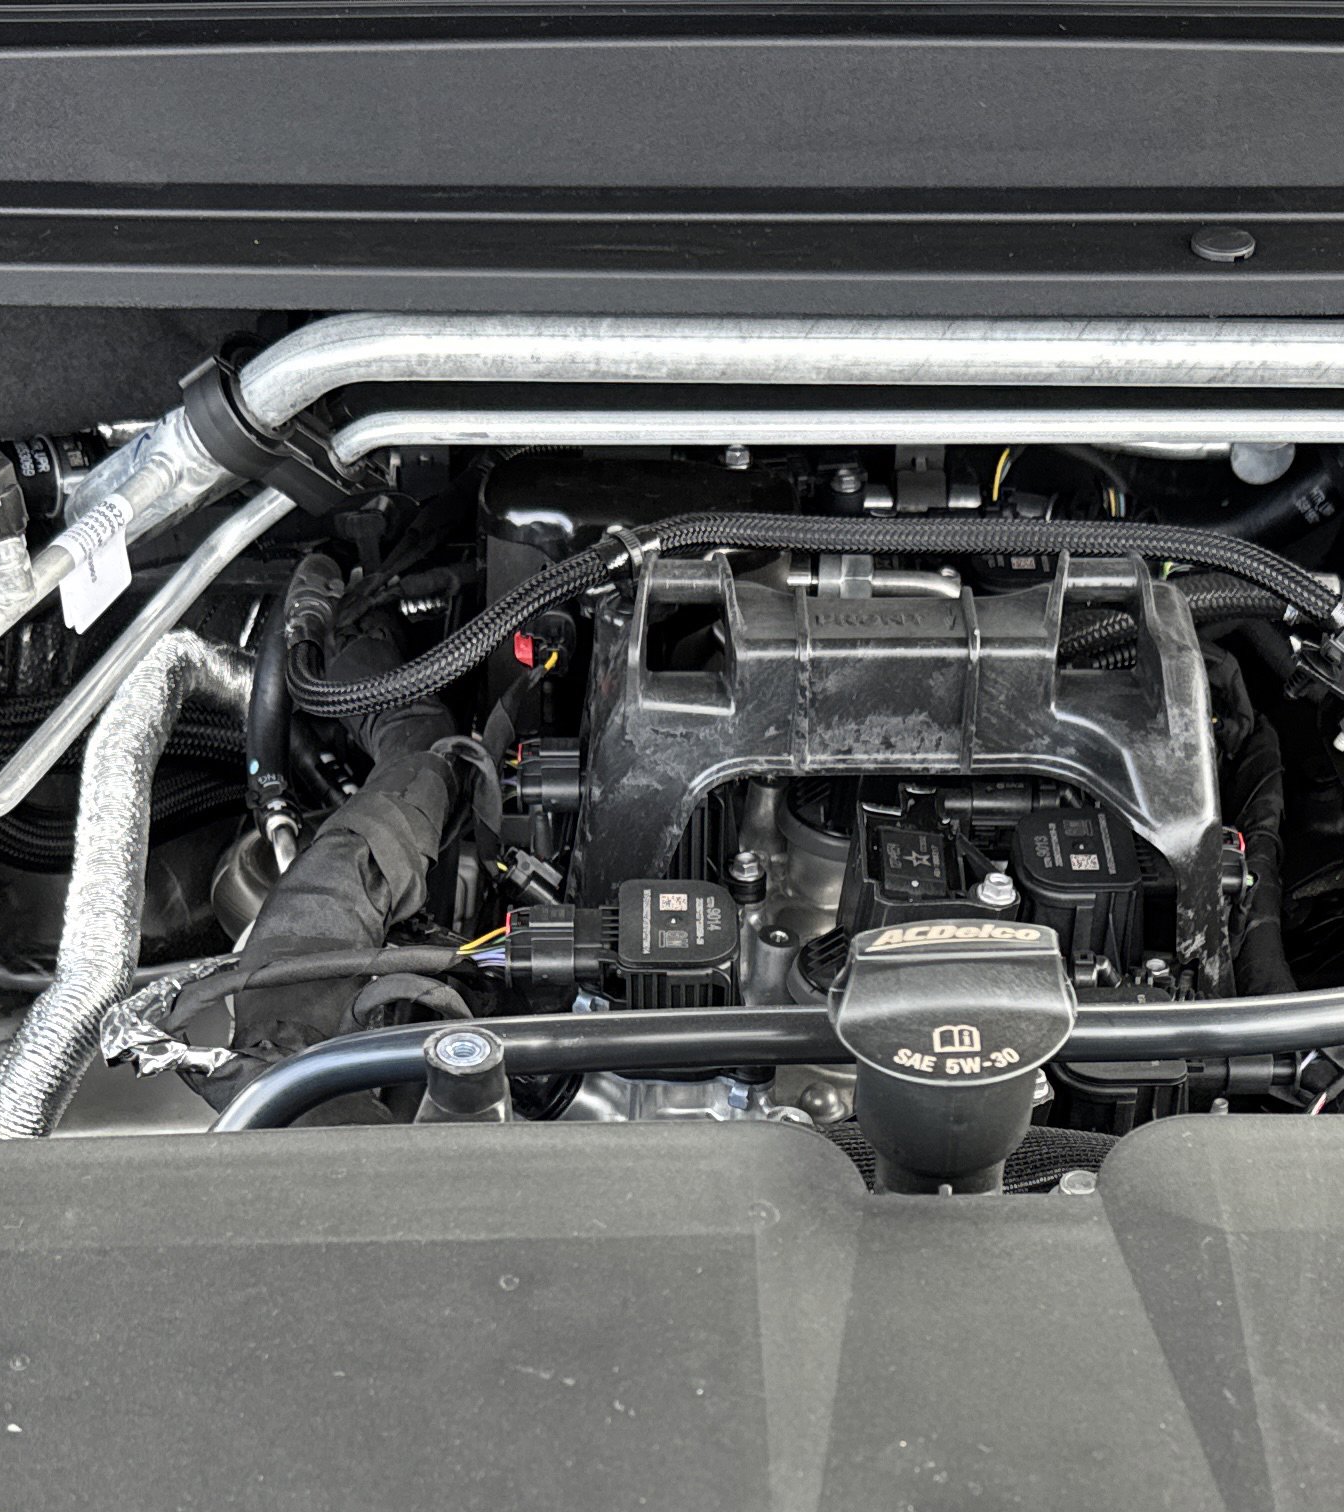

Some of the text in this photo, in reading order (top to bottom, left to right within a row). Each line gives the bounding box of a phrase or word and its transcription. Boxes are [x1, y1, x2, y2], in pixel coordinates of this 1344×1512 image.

[707, 907, 722, 932] 9014
[872, 924, 1041, 946] ACDelco
[893, 1048, 1020, 1074] SAE 5W-30
